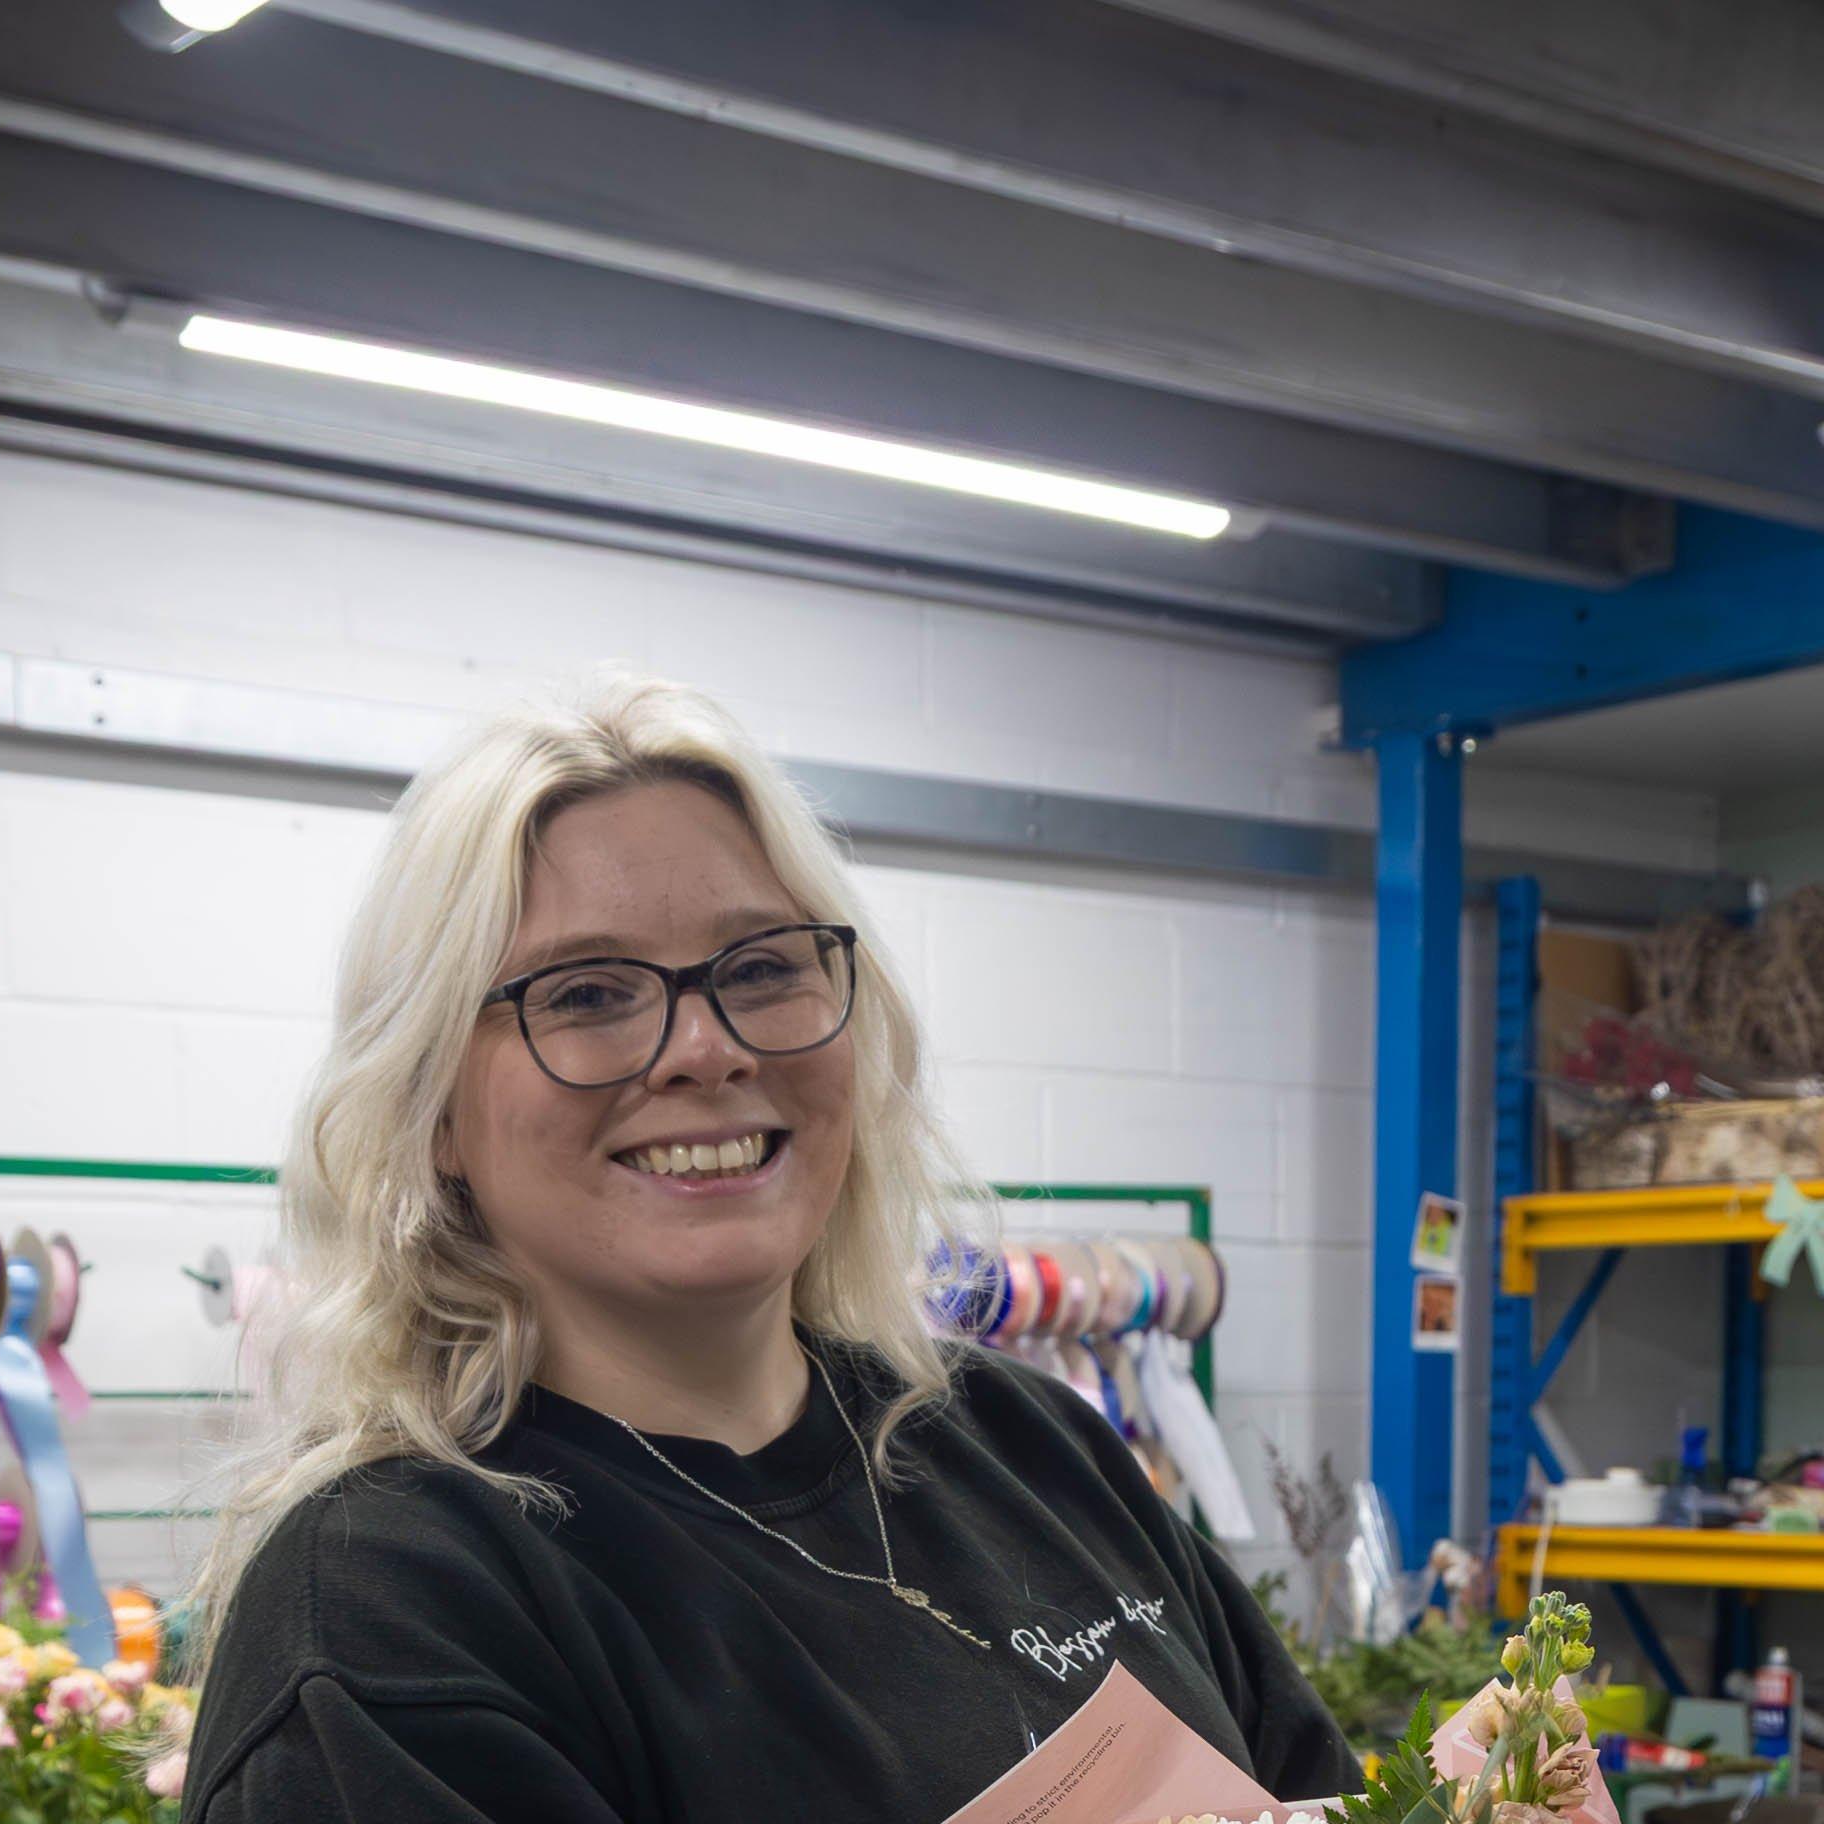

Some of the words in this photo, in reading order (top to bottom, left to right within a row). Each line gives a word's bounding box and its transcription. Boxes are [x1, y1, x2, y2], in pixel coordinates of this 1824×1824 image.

[1031, 1808, 1050, 1823] pop
[1064, 1778, 1079, 1793] the
[1079, 1739, 1113, 1779] recycling
[1036, 1786, 1060, 1806] strict
[1059, 1726, 1114, 1786] environmental
